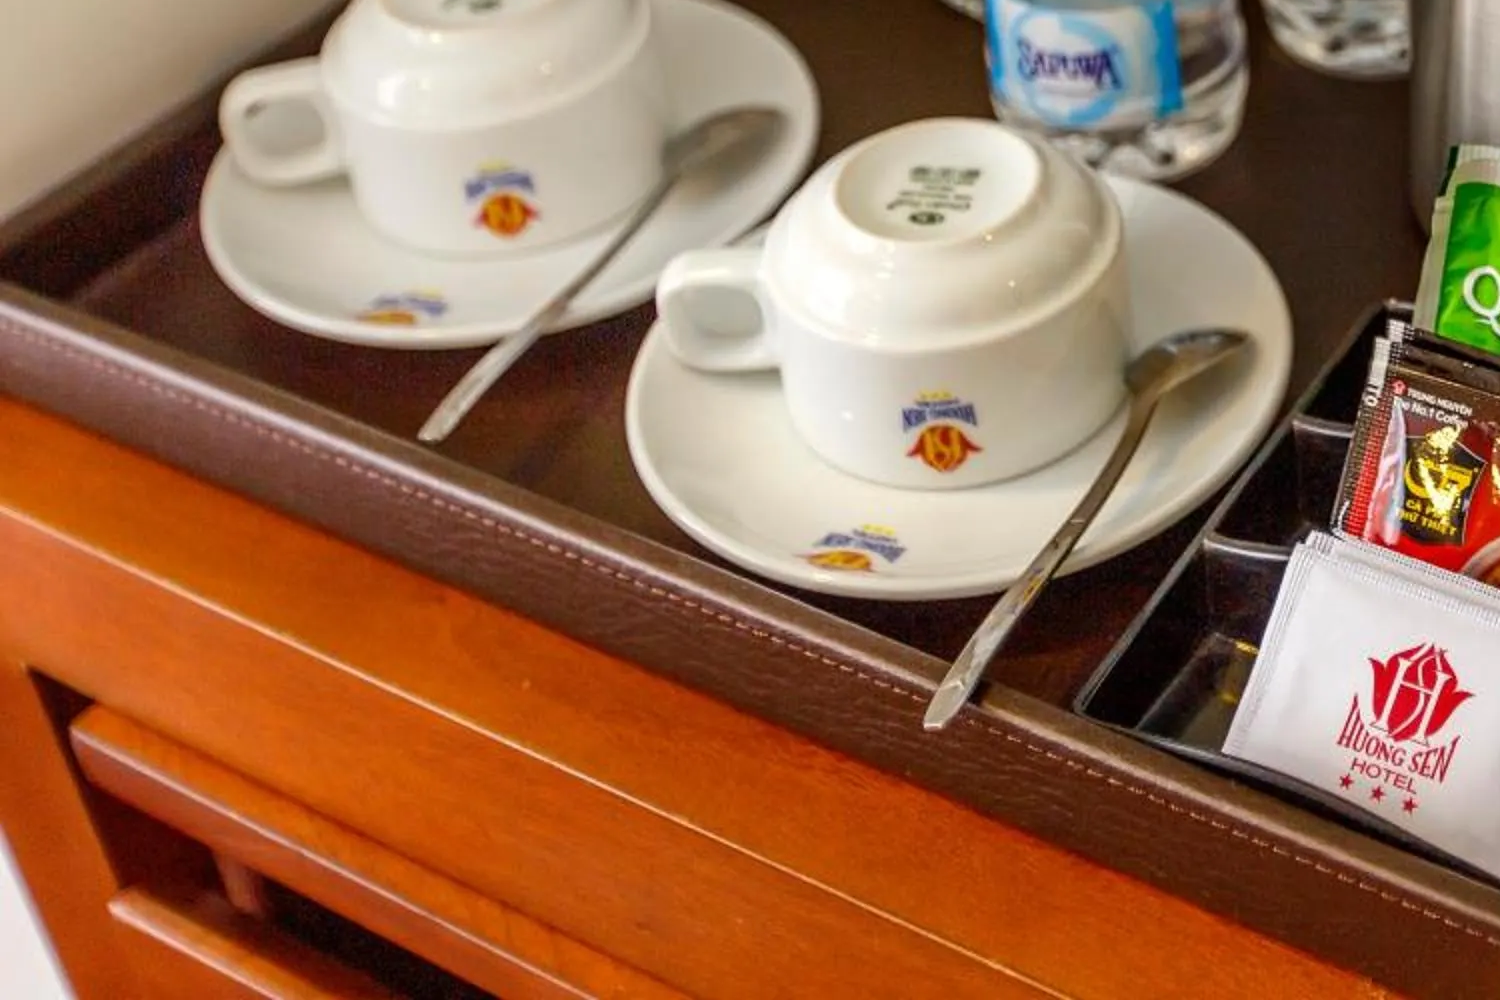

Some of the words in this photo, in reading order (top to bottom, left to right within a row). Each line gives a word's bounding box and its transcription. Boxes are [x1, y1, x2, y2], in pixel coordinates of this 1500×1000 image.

[1336, 692, 1407, 768] HUONG
[1408, 734, 1462, 785] SEN
[1350, 757, 1418, 795] HOTEL
